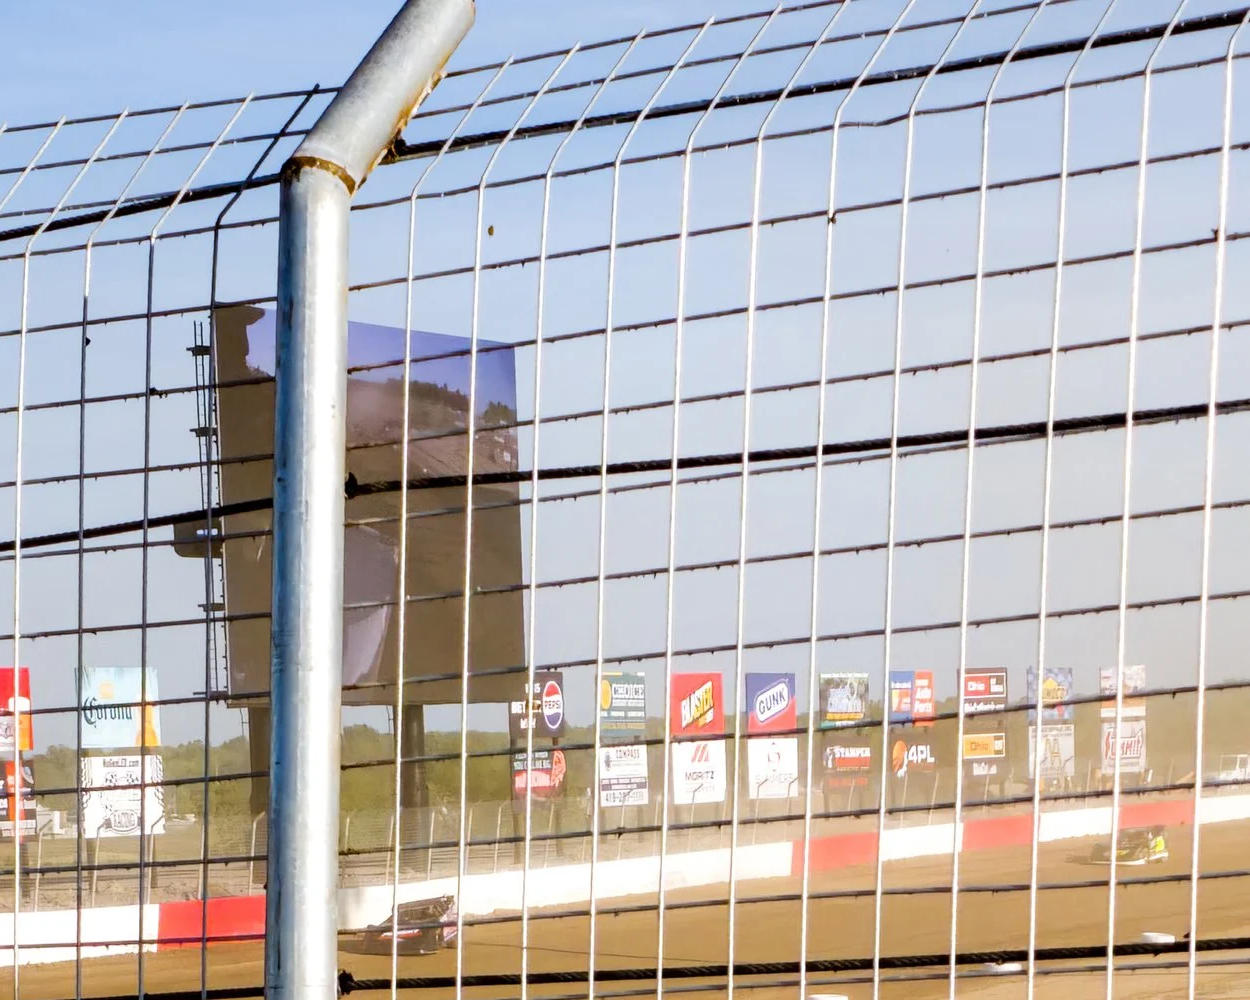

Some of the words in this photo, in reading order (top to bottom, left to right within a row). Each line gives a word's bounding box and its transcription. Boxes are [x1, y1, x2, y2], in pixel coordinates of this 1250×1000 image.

[83, 696, 133, 728] Corona
[758, 687, 787, 716] GUNK
[1104, 730, 1143, 761] SUMIT
